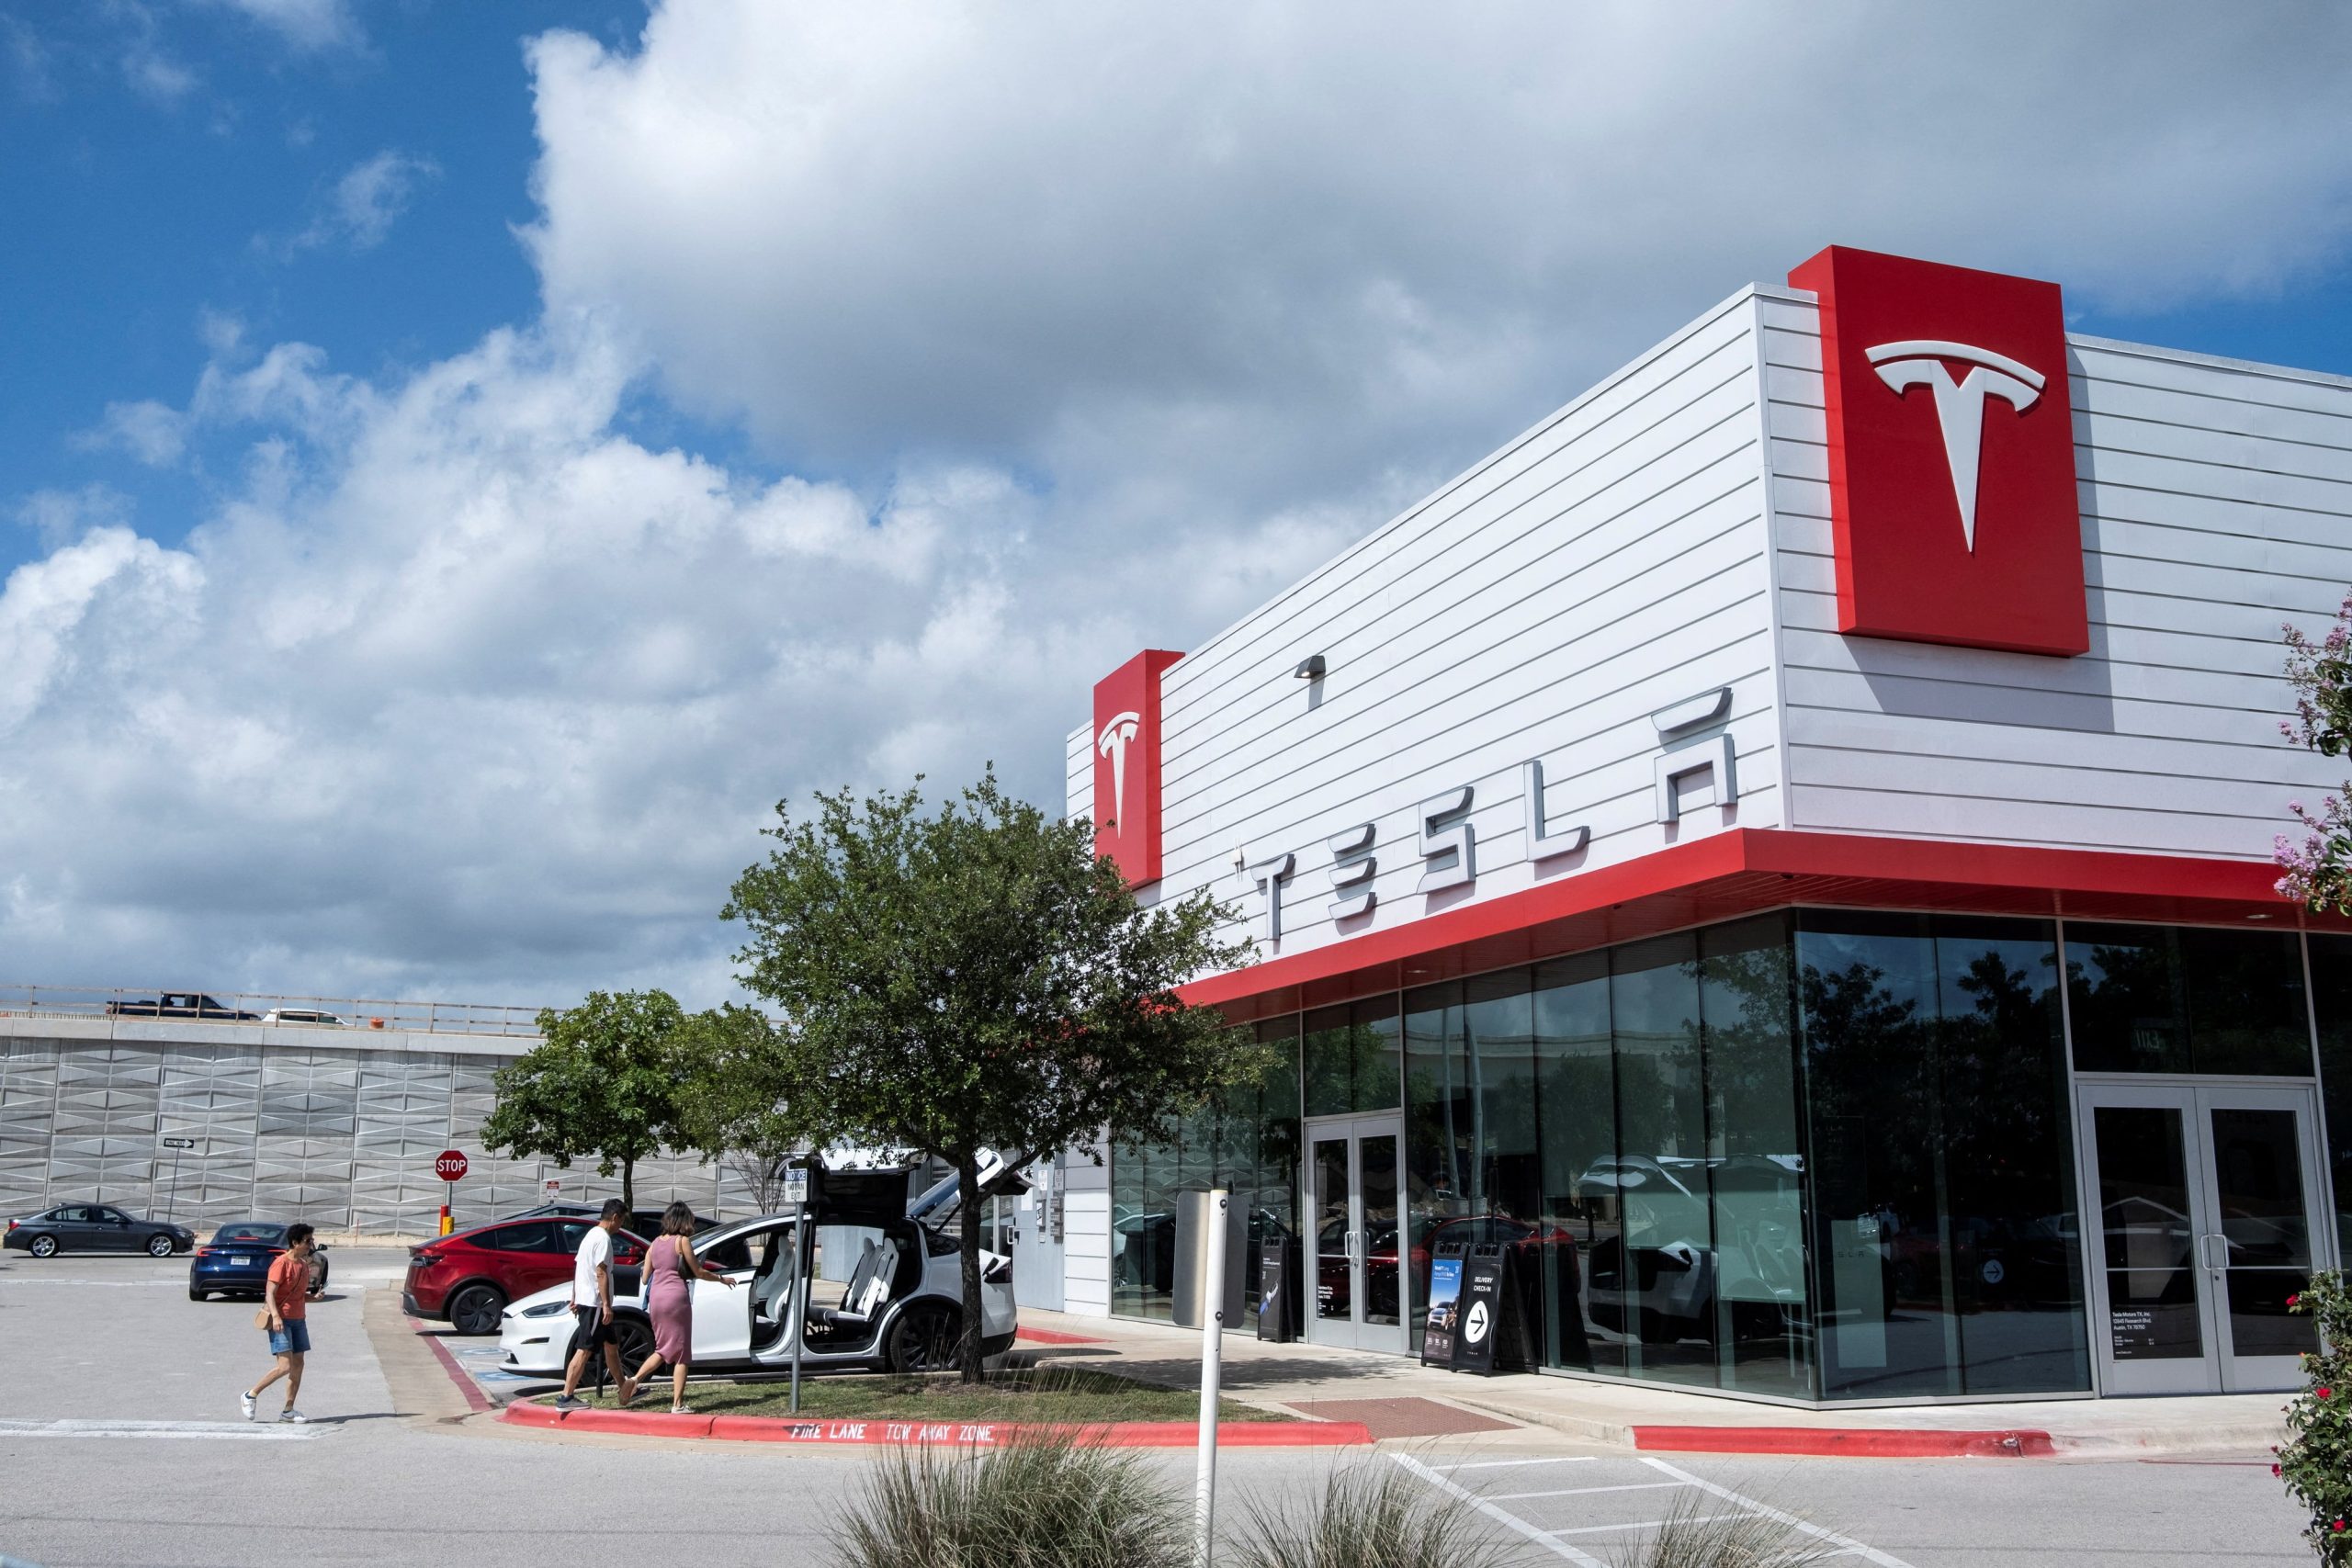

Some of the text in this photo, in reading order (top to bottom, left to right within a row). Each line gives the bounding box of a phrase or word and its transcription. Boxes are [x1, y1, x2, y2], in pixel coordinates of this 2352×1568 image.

[1250, 686, 1739, 941] TESLA
[437, 1159, 466, 1171] STOP
[786, 1171, 806, 1180] NOTICE
[791, 1424, 995, 1441] FIRE LANE TOW AWAY ZONE
